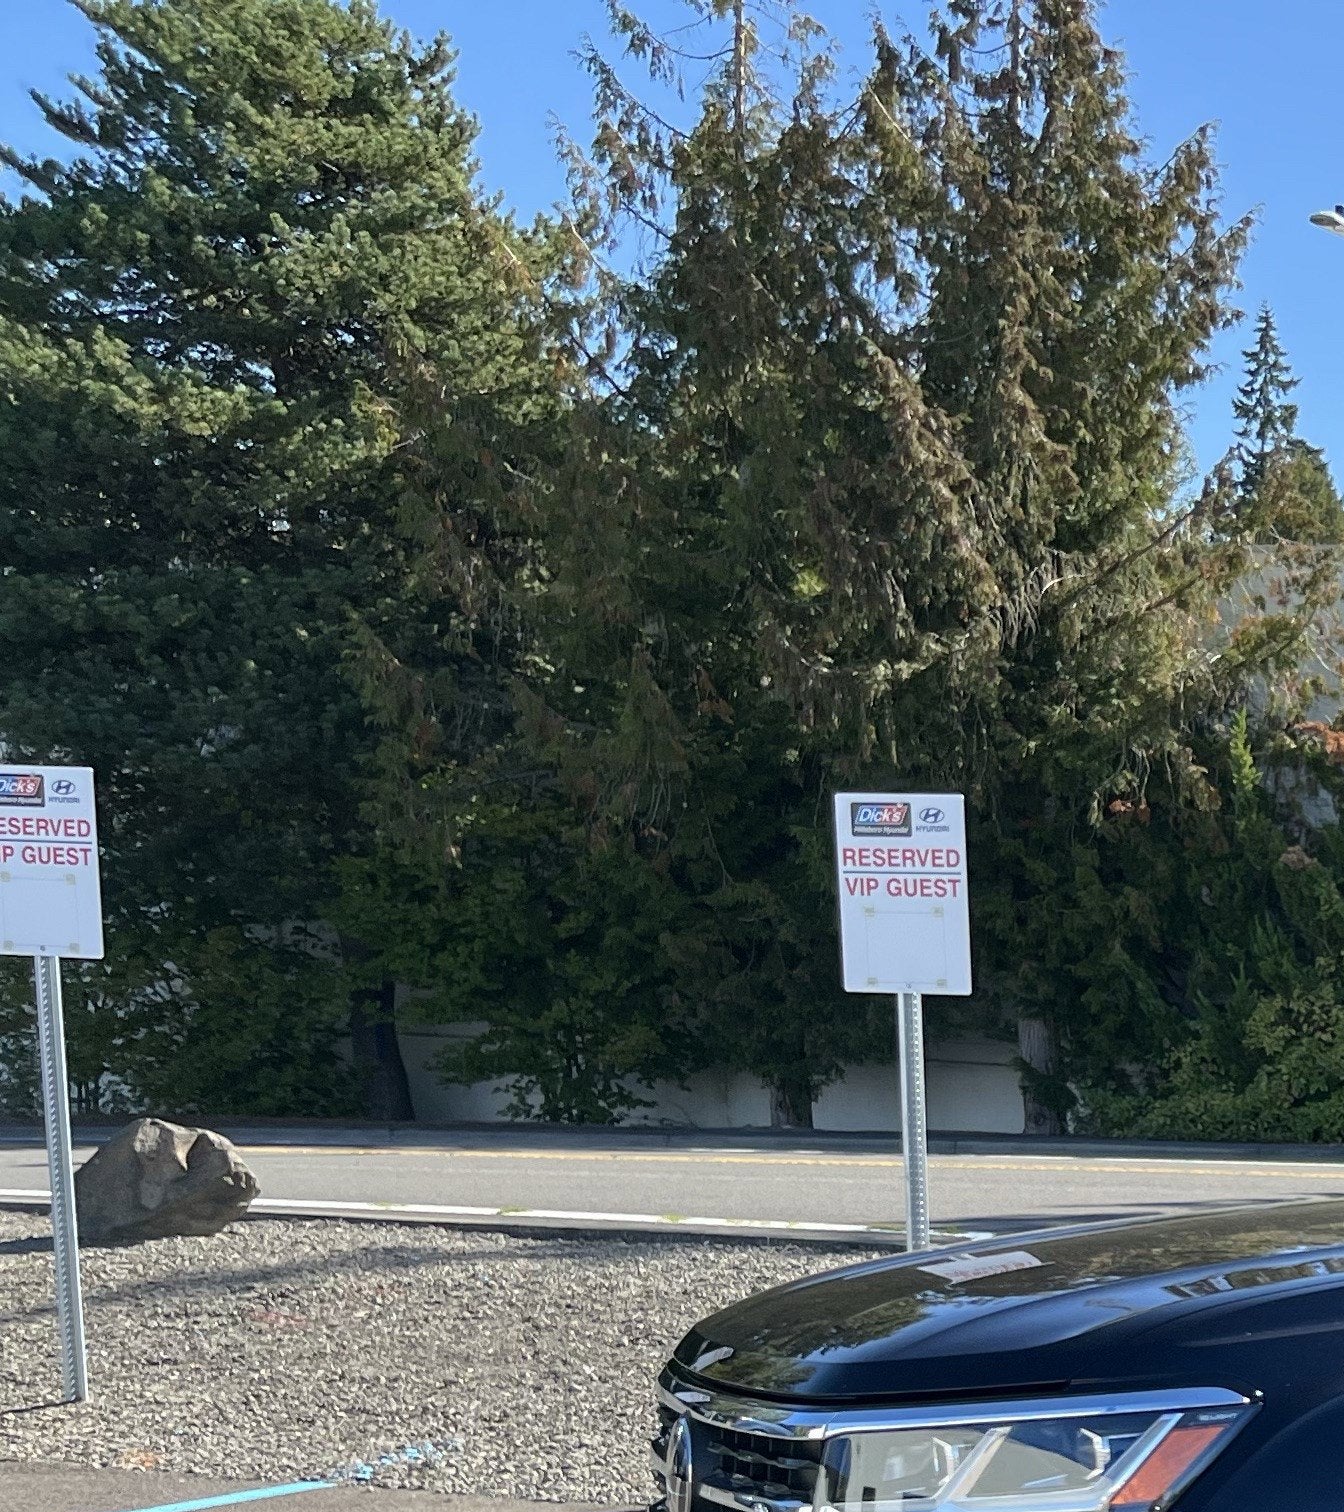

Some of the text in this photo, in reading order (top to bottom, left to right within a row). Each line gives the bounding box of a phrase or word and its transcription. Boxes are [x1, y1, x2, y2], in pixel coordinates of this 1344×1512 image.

[0, 817, 91, 837] ESERVED
[21, 846, 92, 866] GUEST
[842, 848, 960, 868] RESERVED
[845, 877, 961, 898] VIP GUEST
